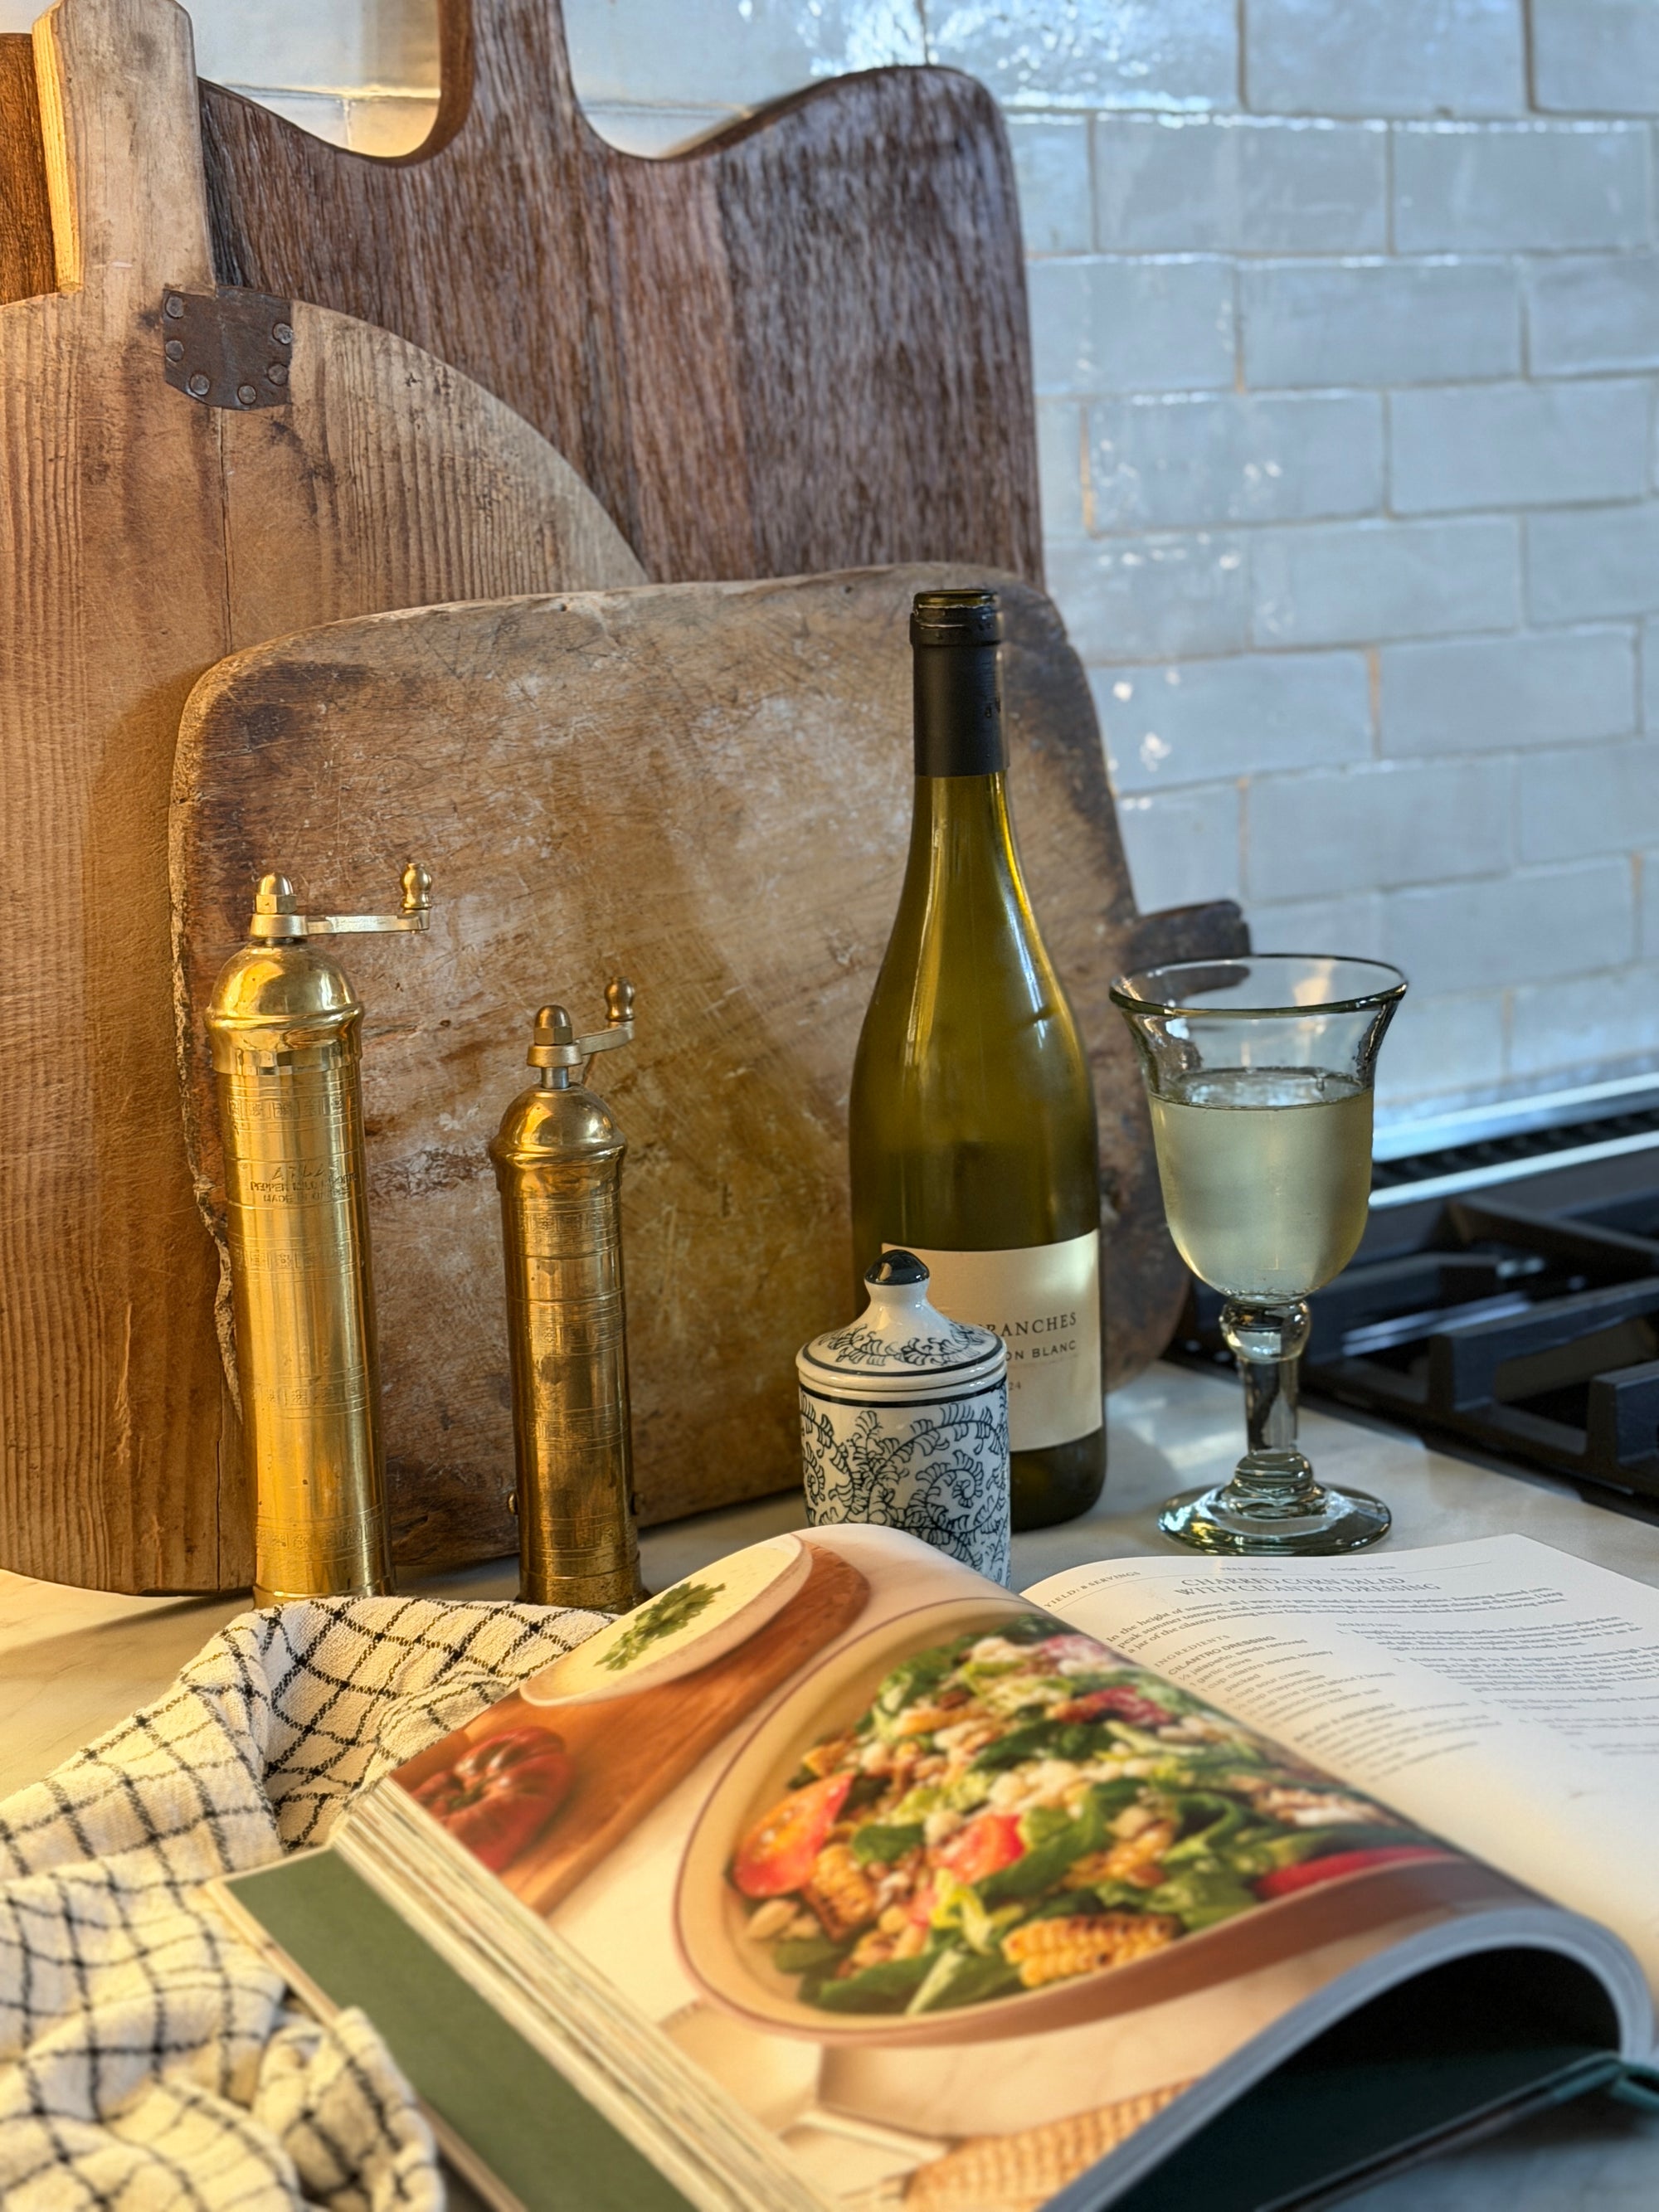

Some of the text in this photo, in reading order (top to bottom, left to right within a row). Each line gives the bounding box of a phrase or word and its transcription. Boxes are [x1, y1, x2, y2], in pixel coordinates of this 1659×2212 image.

[978, 1312, 1077, 1337] RANCHES
[1032, 1340, 1077, 1359] BLANC
[1044, 1587, 1080, 1608] YIELD:
[1088, 1571, 1141, 1586] SERVINGS
[1174, 1583, 1442, 1596] WITH CILANTRO DRESSING
[1181, 1578, 1279, 1587] CHARRED
[1282, 1578, 1340, 1586] CORN
[1117, 1633, 1144, 1650] peak
[1143, 1616, 1182, 1631] summer
[1120, 1624, 1138, 1635] the
[1137, 1612, 1170, 1627] height
[1136, 1641, 1149, 1650] jar
[1150, 1632, 1163, 1641] of
[1161, 1626, 1180, 1636] the
[1180, 1616, 1217, 1630] cilantro
[1154, 1634, 1231, 1668] INGREDIENTS
[1167, 1635, 1277, 1675] CILANTRO DRESSING
[1235, 1646, 1265, 1656] seeds
[1266, 1639, 1307, 1648] removed
[1197, 1666, 1225, 1685] garlic
[1225, 1657, 1253, 1669] clove
[1208, 1676, 1228, 1690] cup
[1228, 1663, 1265, 1679] cilantro
[1224, 1673, 1262, 1693] packed
[1234, 1670, 1311, 1699] cup sour cream
[1247, 1692, 1267, 1705] cup
[1267, 1674, 1327, 1694] mayonnaise
